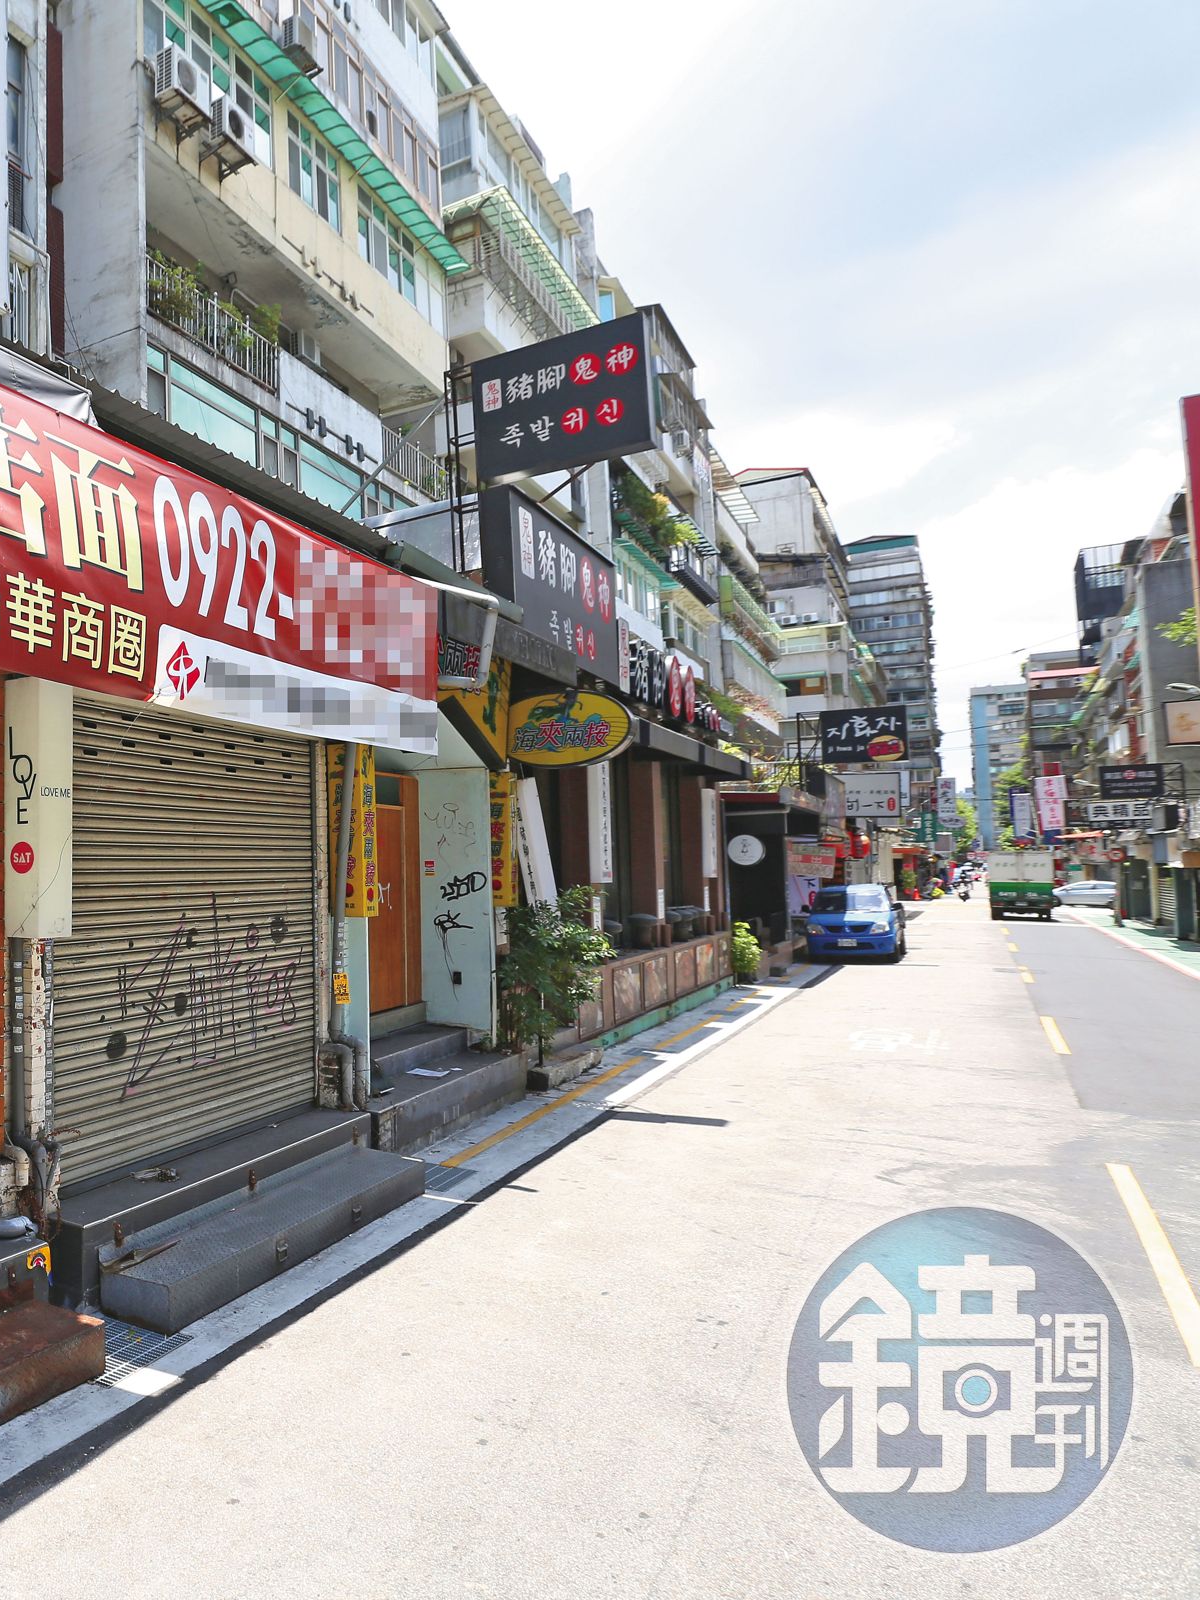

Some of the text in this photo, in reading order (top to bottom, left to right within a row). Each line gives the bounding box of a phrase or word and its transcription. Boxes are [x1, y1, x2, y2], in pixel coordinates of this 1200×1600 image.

[505, 345, 634, 404] 豬腳鬼神
[538, 530, 611, 617] 豬腳鬼神
[511, 720, 610, 753] 海夾兩按
[826, 715, 902, 740] 지화자
[8, 726, 37, 825] LOVE
[40, 786, 71, 798] LOVE ME
[13, 852, 31, 864] SAT
